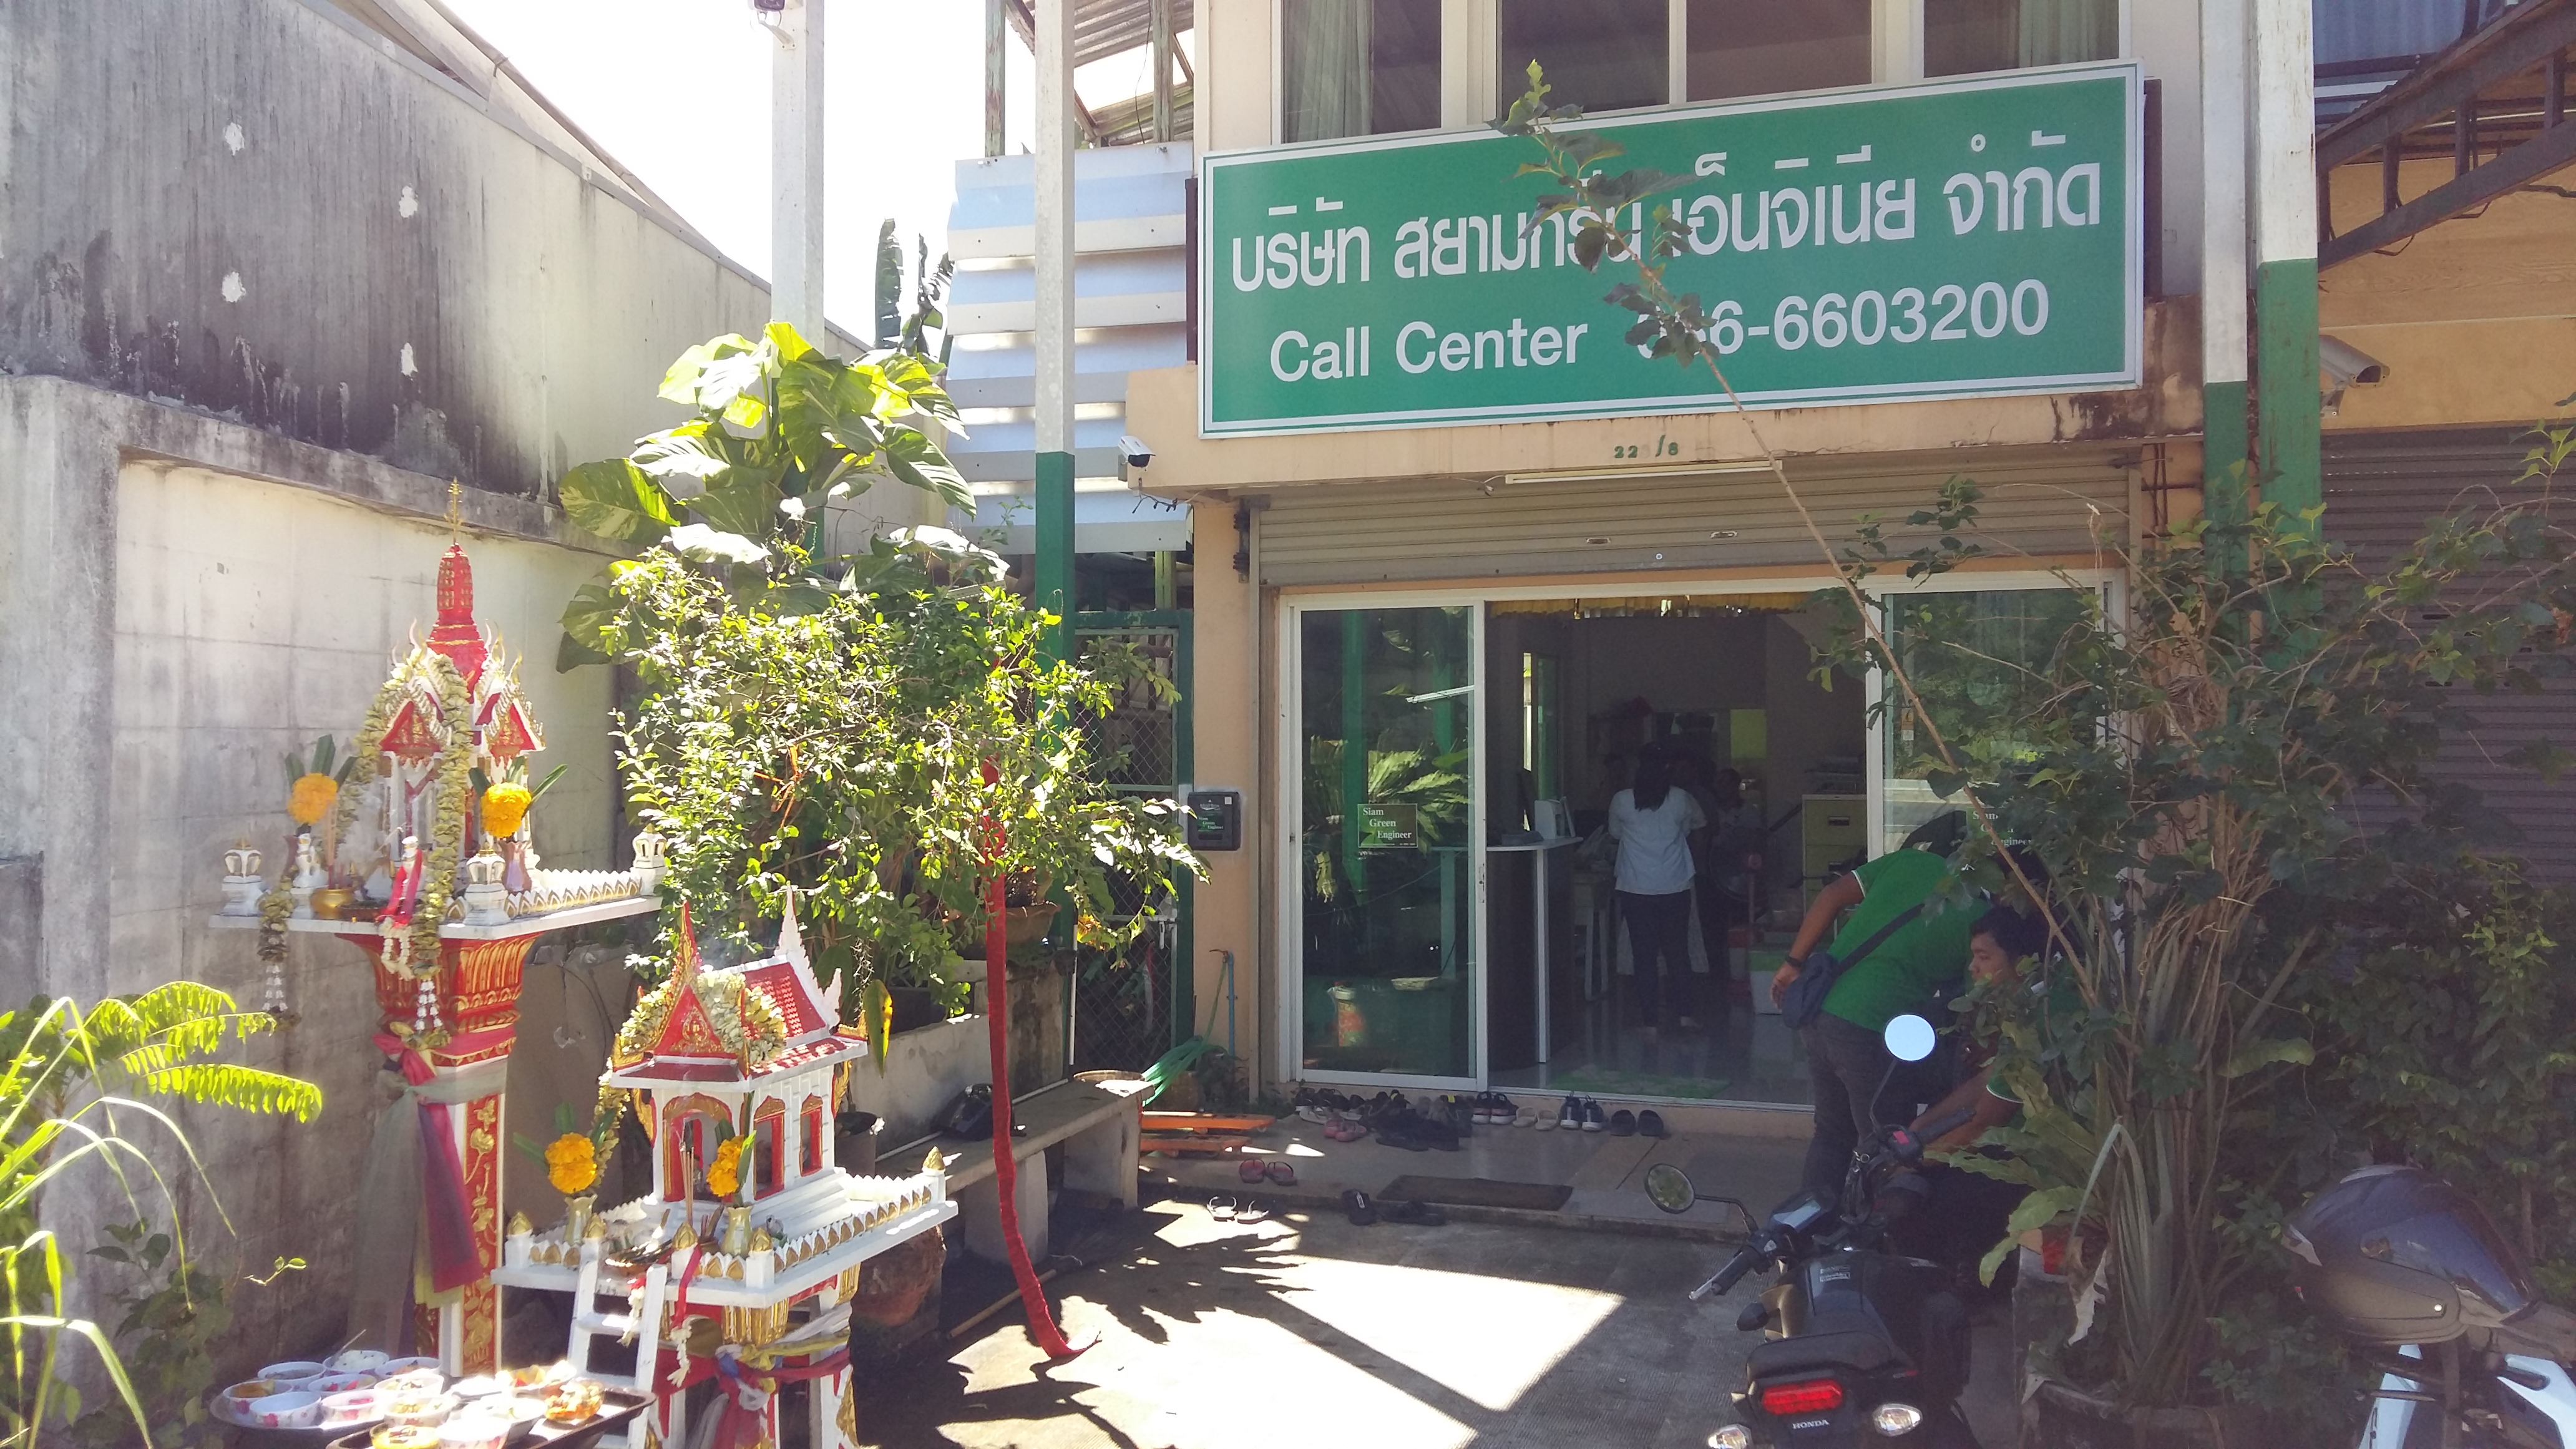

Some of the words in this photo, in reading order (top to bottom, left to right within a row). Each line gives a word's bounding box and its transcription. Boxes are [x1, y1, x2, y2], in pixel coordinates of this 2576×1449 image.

[1232, 197, 1370, 292] บริษัท
[1943, 130, 2100, 235] จำกัด
[1270, 326, 1369, 382] Call
[1395, 318, 1588, 374] Center
[1637, 278, 2049, 359] 6-6603200
[1363, 807, 1384, 816] Siam
[1369, 819, 1396, 827] Green
[1377, 831, 1412, 841] Engineer
[1991, 837, 2032, 847] gineer
[1792, 1420, 1830, 1429] HONDA
